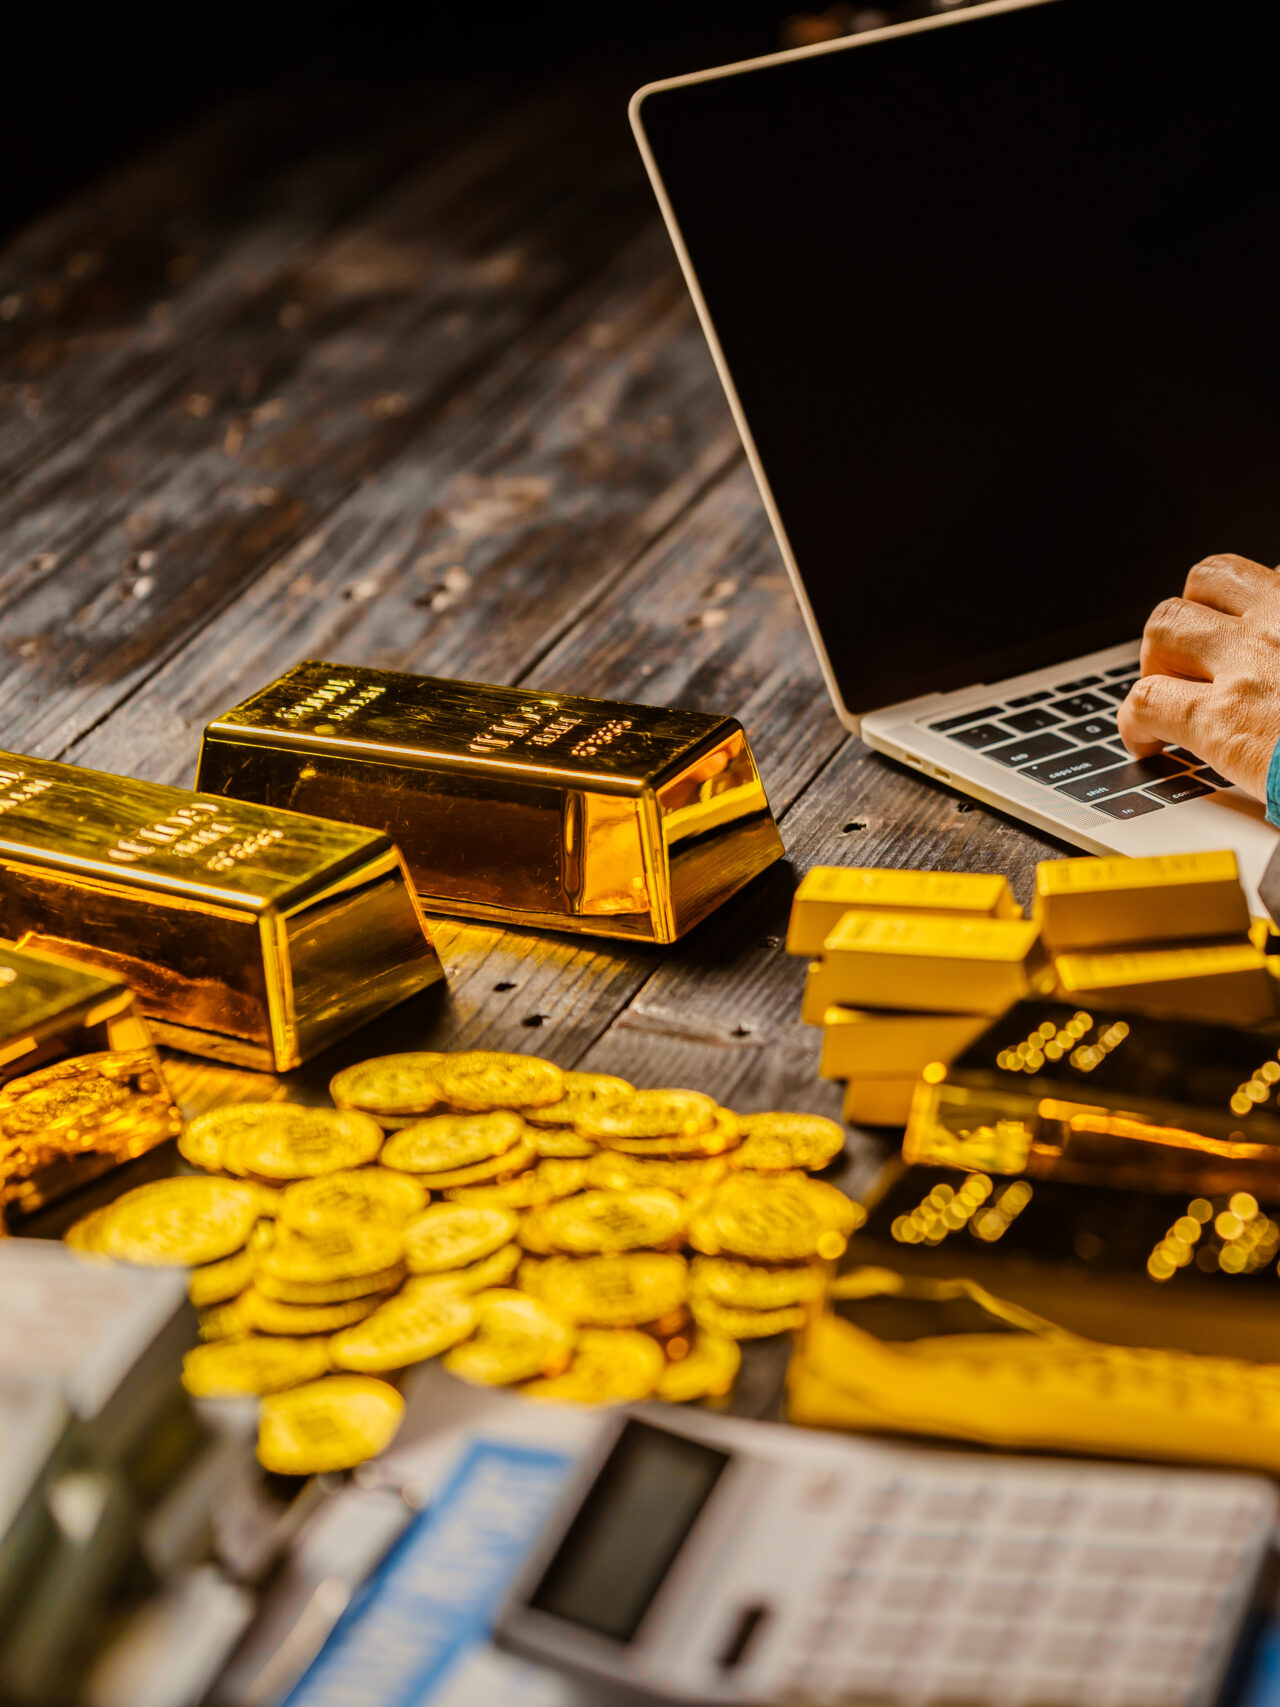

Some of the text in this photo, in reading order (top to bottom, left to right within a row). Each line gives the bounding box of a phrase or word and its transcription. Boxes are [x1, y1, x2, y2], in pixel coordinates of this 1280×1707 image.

[1049, 762, 1092, 779] caps lock
[1086, 787, 1109, 797] shift
